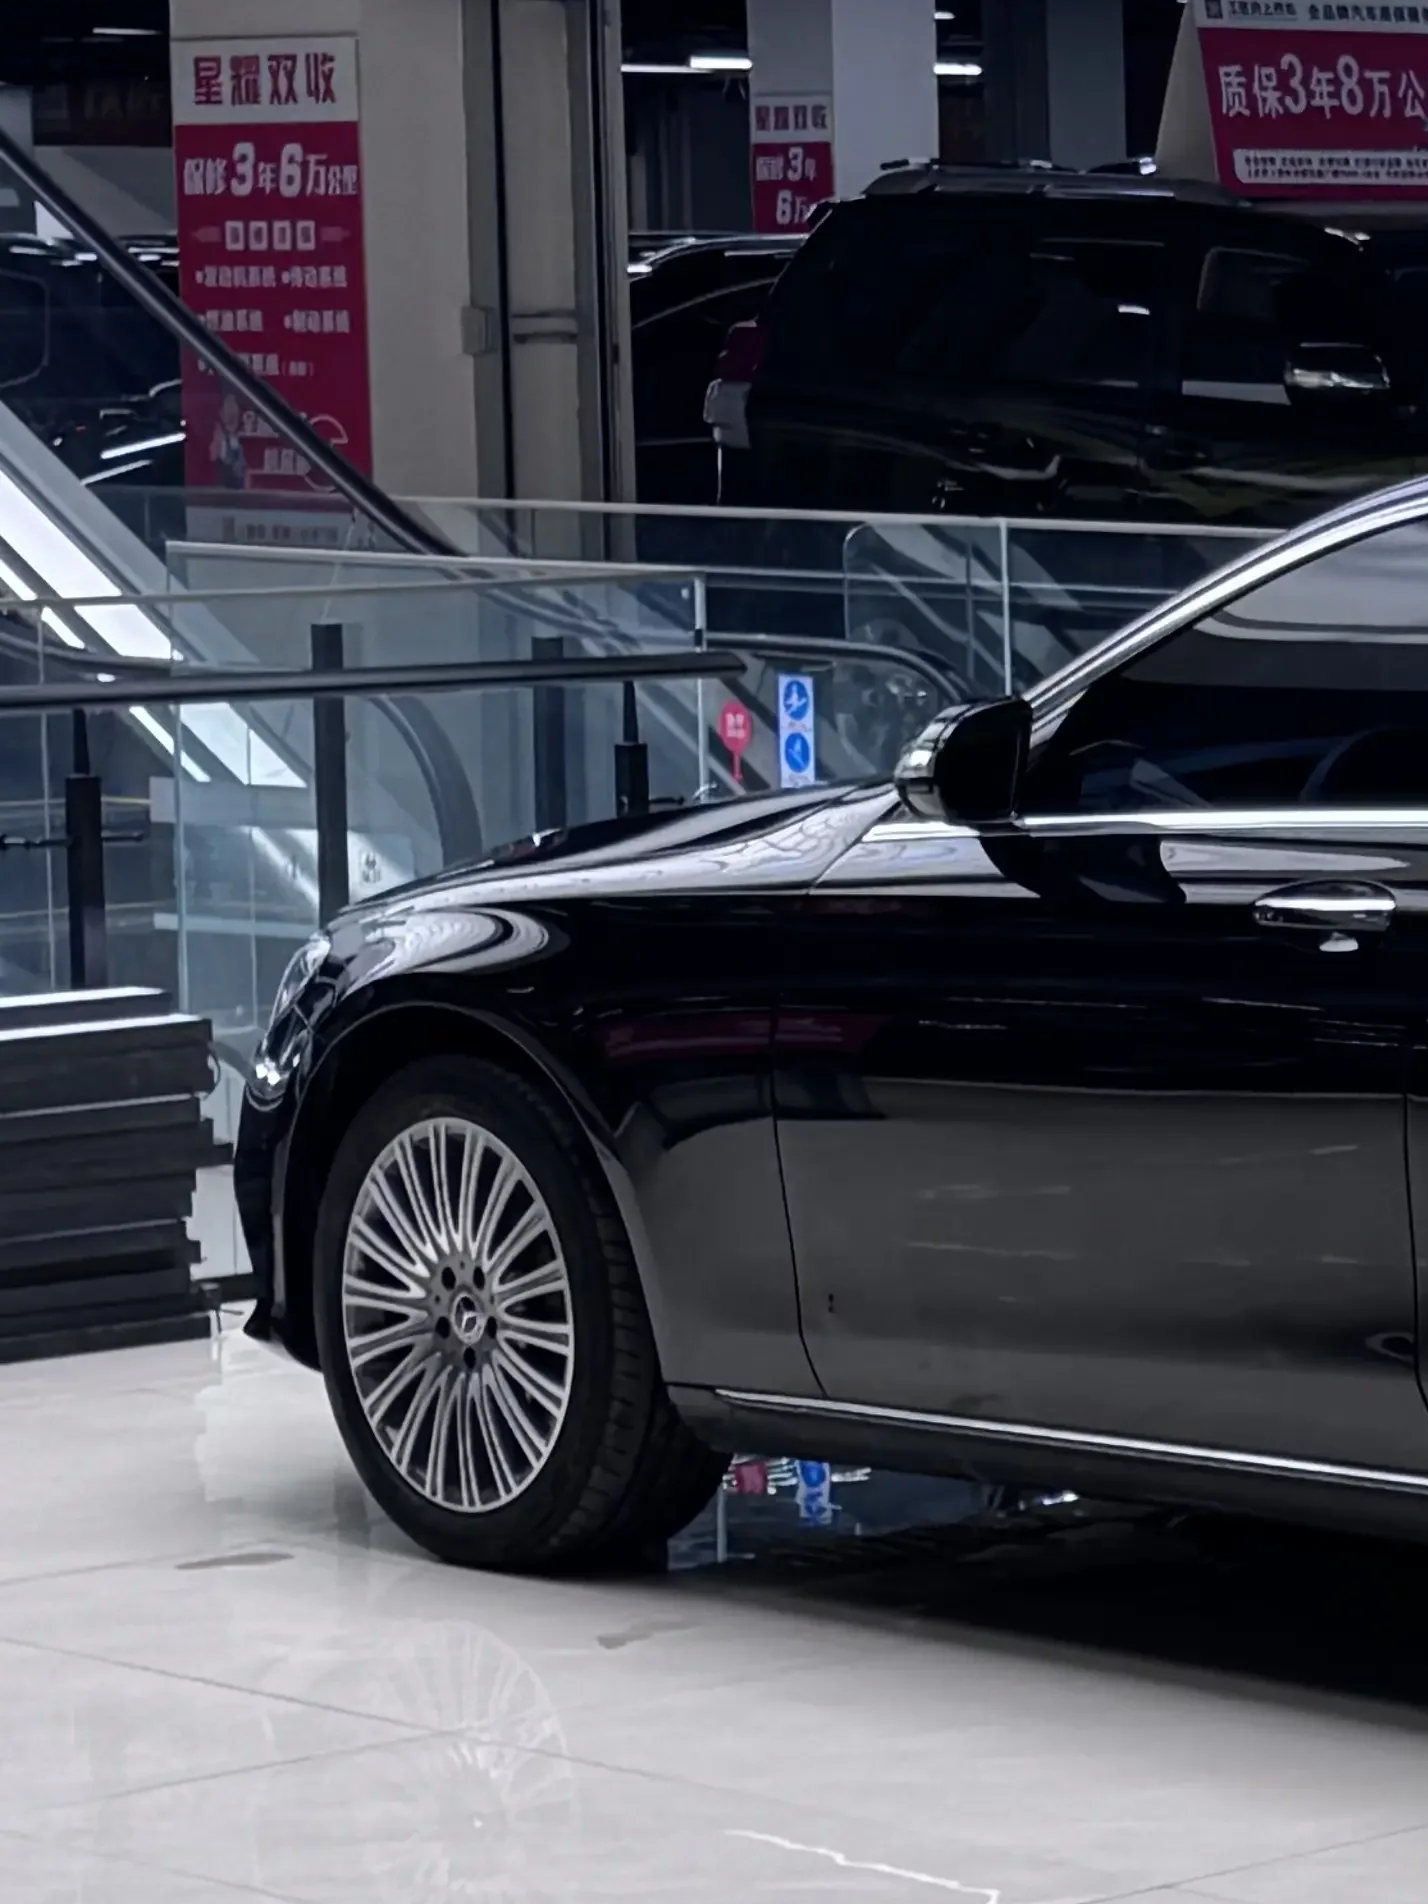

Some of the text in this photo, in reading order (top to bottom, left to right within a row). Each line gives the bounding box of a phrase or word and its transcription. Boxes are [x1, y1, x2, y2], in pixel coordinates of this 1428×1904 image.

[183, 142, 358, 198] 保修3年6万公里
